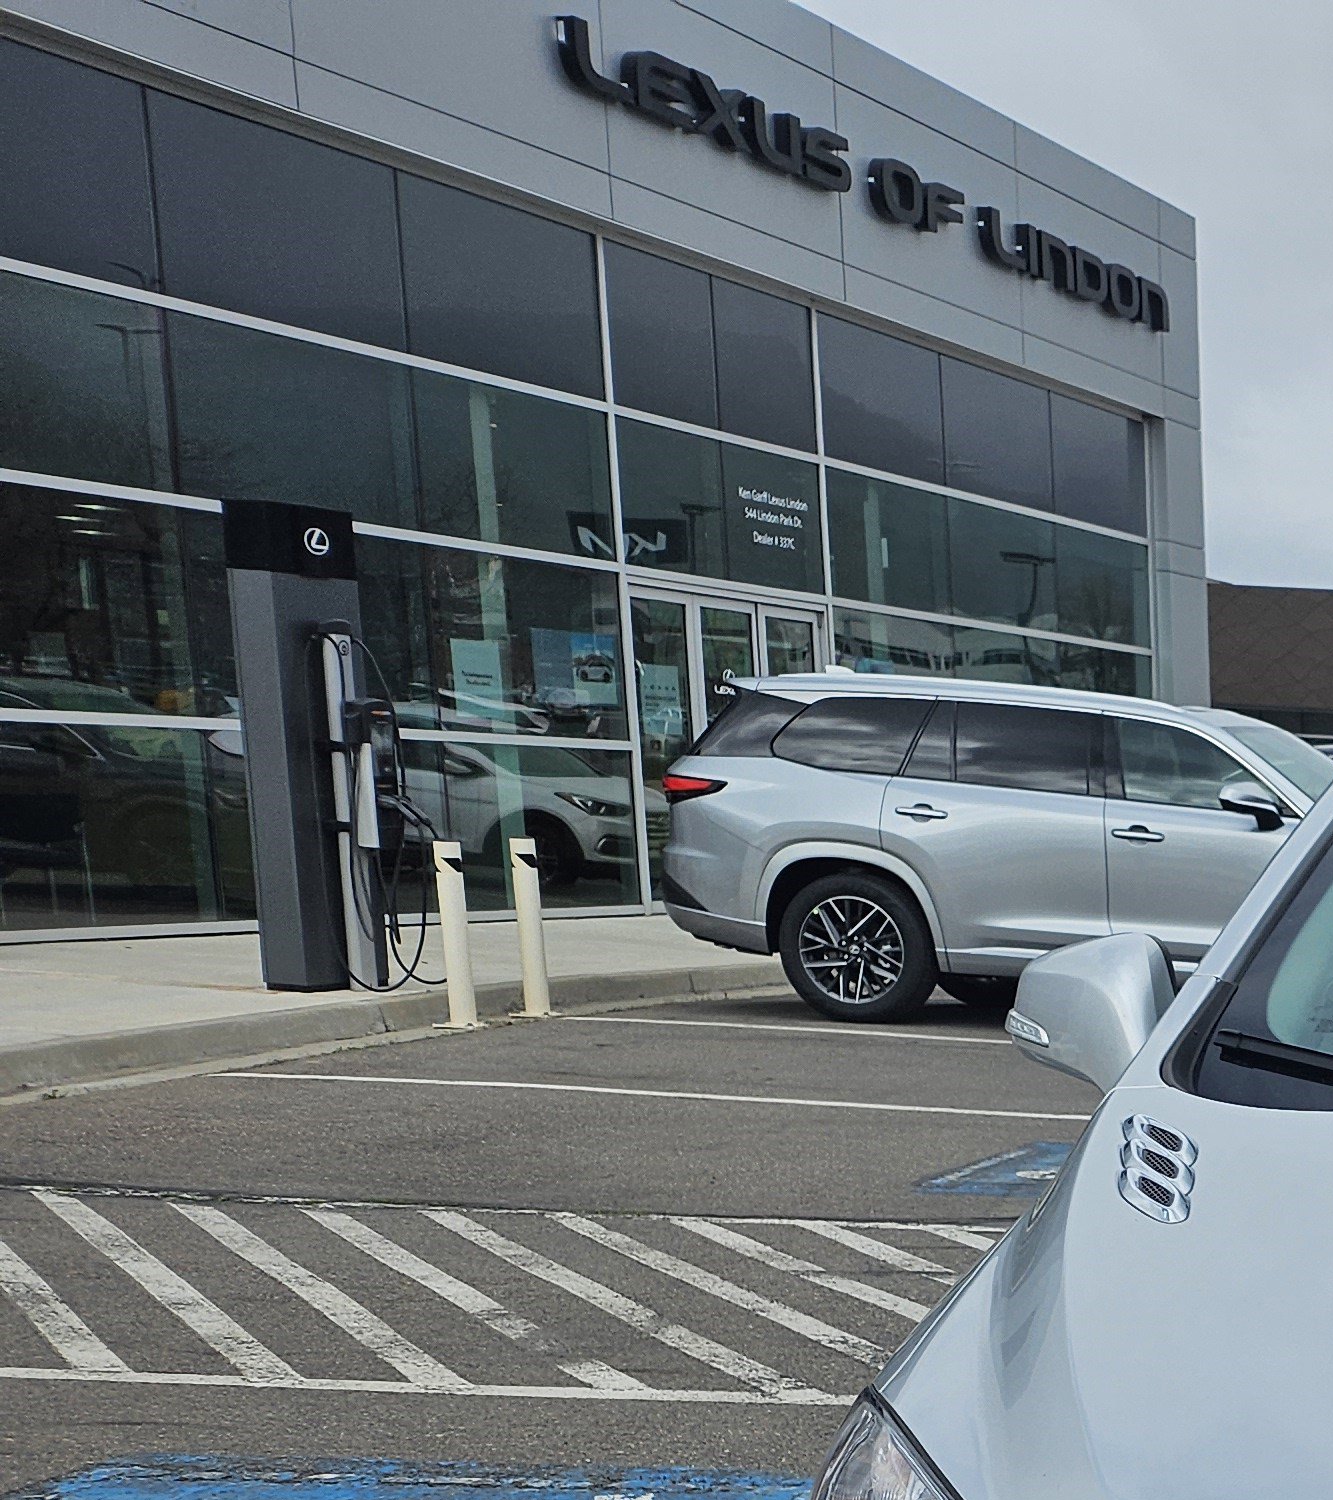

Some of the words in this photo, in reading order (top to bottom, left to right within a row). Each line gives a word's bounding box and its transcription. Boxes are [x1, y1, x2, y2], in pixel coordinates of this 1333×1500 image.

[554, 14, 852, 193] LEXUS
[868, 157, 965, 233] OF
[768, 493, 786, 507] Lexus
[786, 497, 809, 511] Lindon
